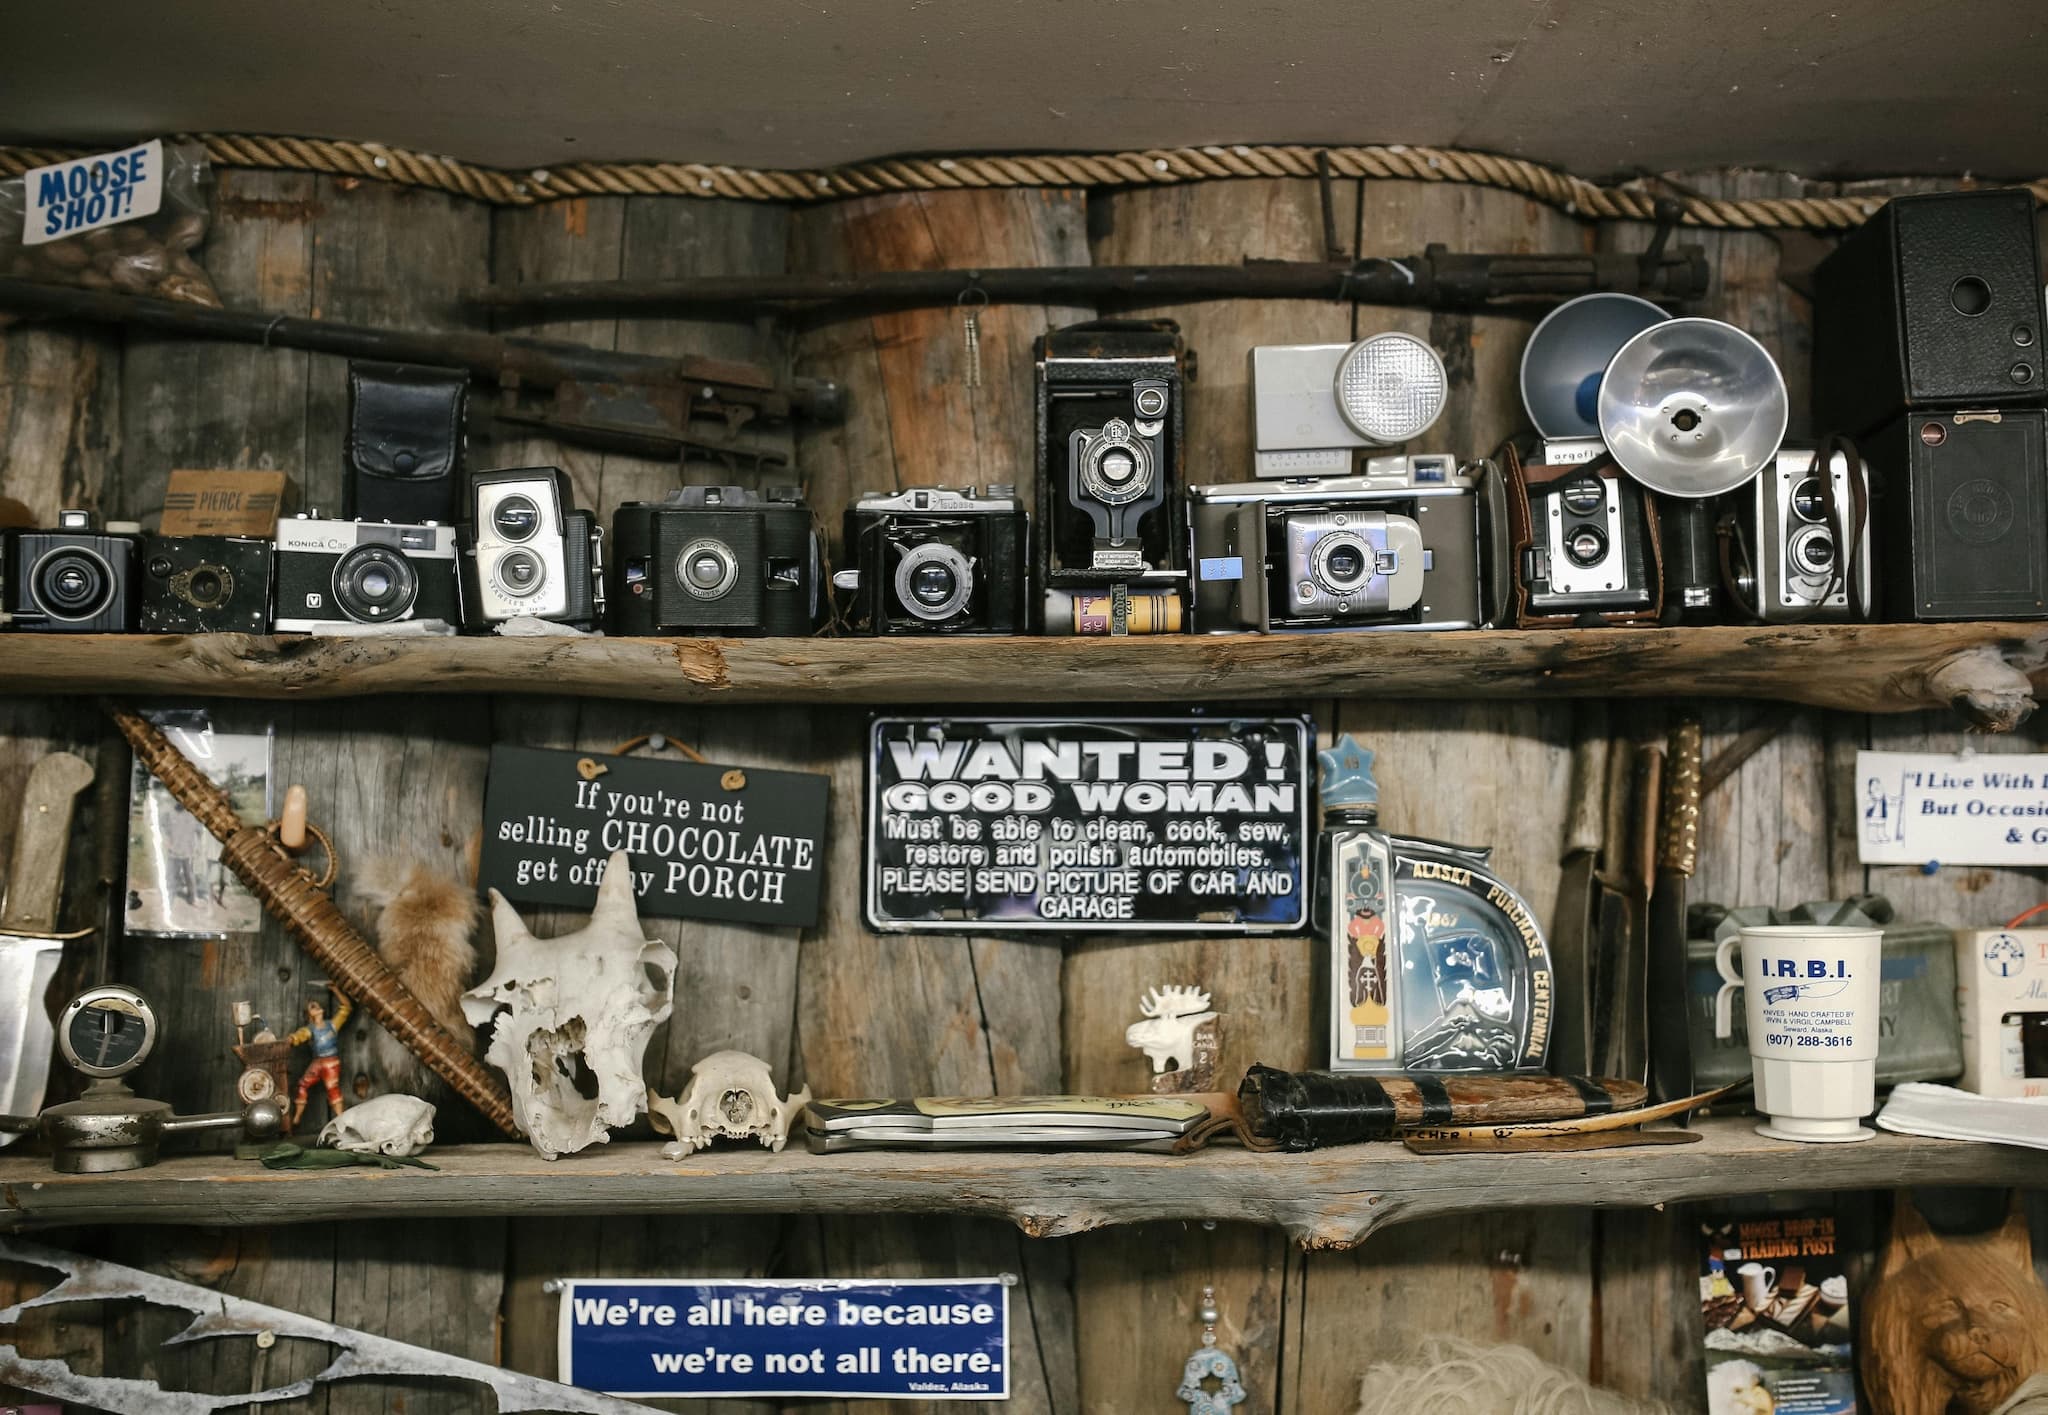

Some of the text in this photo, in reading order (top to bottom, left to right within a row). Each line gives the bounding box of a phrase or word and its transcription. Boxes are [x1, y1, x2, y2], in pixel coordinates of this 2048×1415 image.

[38, 149, 147, 208] MOOSE
[45, 185, 133, 235] SHOT!
[1554, 449, 1602, 460] argofl
[199, 490, 242, 512] PIERCE
[940, 498, 974, 509] Tsubasa
[288, 540, 324, 548] KONICA
[888, 740, 1286, 781] WANTED!
[1927, 771, 1975, 789] Live
[1983, 772, 2035, 789] With
[575, 780, 744, 825] If you're not
[886, 780, 1296, 813] GOOD WOMAN
[1921, 799, 1959, 815] But
[886, 814, 1289, 844] Must be able to clean, cook, sew,
[2005, 827, 2023, 844] &
[498, 815, 814, 871] selling CHOCOLATE
[905, 841, 1271, 869] restore and polish automobiles.
[516, 856, 786, 904] get off y PORCH
[882, 868, 1293, 896] PLEASE SEND PICTURE OF CAR AND
[1040, 896, 1135, 919] GARAGE
[1412, 862, 1551, 1059] ALASKA PURCHASE CENTENNIAL
[1761, 958, 1852, 978] I.R.B.I.
[1763, 1009, 1785, 1017] KNIVES
[1788, 1010, 1809, 1018] HAND
[1766, 1034, 1853, 1048] (907) 288-3616
[1741, 1236, 1836, 1260] TRADING POST
[573, 1298, 995, 1327] We're all here because
[651, 1346, 1002, 1375] we're not all there.
[907, 1382, 990, 1392] Valdez, Alaska
